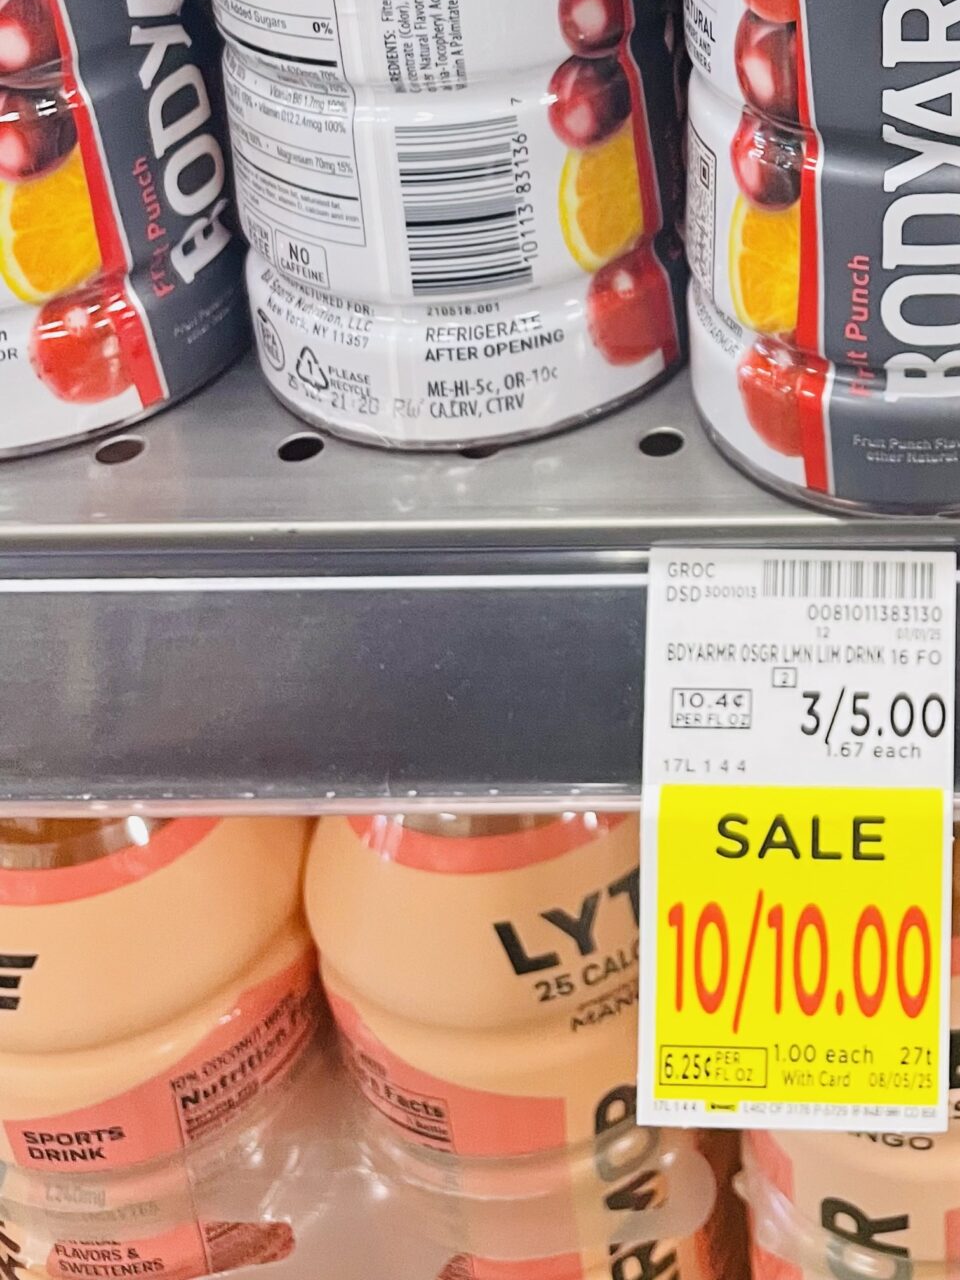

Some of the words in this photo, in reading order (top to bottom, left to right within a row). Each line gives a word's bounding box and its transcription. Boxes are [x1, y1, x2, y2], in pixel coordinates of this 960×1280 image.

[312, 21, 334, 36] 0%
[512, 132, 532, 194] 83136
[132, 156, 167, 240] Punch
[289, 242, 310, 266] NO
[281, 258, 326, 284] CAFFEINE
[845, 254, 870, 342] Punch
[312, 324, 328, 339] NY
[425, 345, 479, 362] AFTER
[484, 329, 565, 358] OPENING
[667, 563, 715, 578] GROC
[666, 586, 701, 602] DSD
[808, 604, 942, 622] 0081011383130
[816, 626, 830, 639] 12
[891, 649, 909, 665] 16
[916, 650, 942, 665] FO
[677, 692, 744, 709] 10.4¢
[675, 714, 702, 726] PER
[707, 714, 723, 726] FL
[727, 714, 750, 726] OZ
[800, 686, 946, 745] 3/5.00
[826, 741, 864, 758] 1.67
[873, 741, 921, 759] each
[663, 758, 695, 773] 17L
[715, 813, 886, 862] SALE
[493, 865, 640, 975] LYT
[667, 889, 932, 1034] 10/10.00
[534, 973, 575, 1002] 25
[715, 1051, 741, 1064] PER
[774, 1044, 816, 1063] 1.00
[826, 1045, 874, 1065] each
[900, 1046, 932, 1066] 27t
[715, 1068, 729, 1081] FL
[737, 1068, 753, 1082] OZ
[782, 1070, 813, 1086] With
[818, 1070, 850, 1087] Card
[22, 1125, 126, 1147] SPORTS
[28, 1146, 107, 1162] DRINK
[54, 1242, 123, 1262] FLAVORS
[127, 1247, 139, 1260] &
[58, 1257, 165, 1277] SWEETENERS
